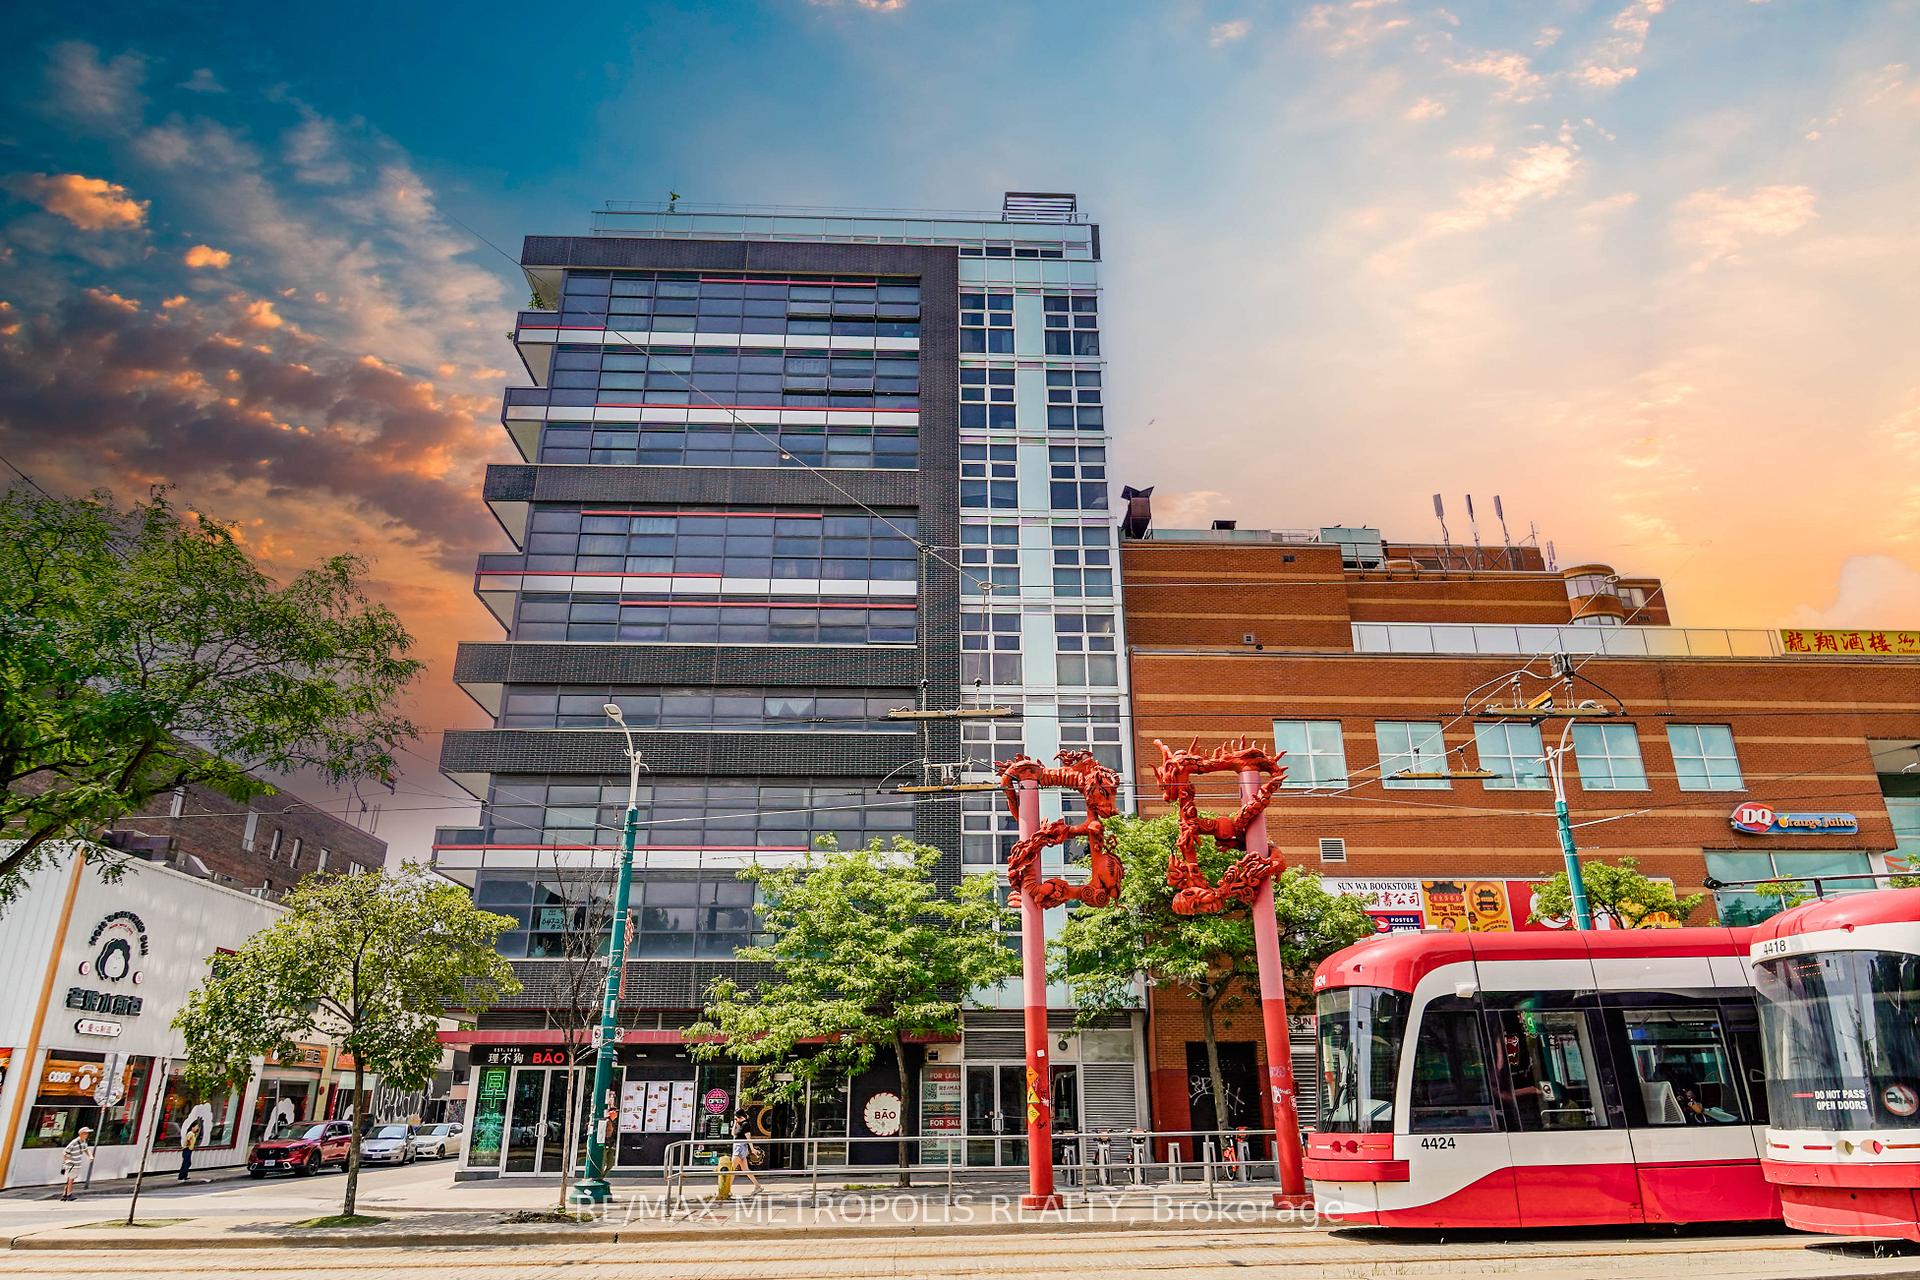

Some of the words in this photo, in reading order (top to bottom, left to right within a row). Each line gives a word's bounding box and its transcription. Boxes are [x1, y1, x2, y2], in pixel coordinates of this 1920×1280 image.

[1898, 632, 1915, 648] Sky
[1741, 808, 1773, 827] DQ
[1778, 814, 1821, 829] Orange
[1337, 882, 1353, 890] SUN
[1354, 882, 1368, 890] WA
[1369, 882, 1418, 890] BOOKSTORE
[1763, 940, 1786, 955] 4418
[1814, 1091, 1825, 1099] DO
[1826, 1090, 1841, 1099] NOT
[1842, 1089, 1866, 1099] PASS
[1816, 1101, 1836, 1110] OPEN
[1837, 1101, 1868, 1110] DOORS
[1421, 1137, 1456, 1149] 4424
